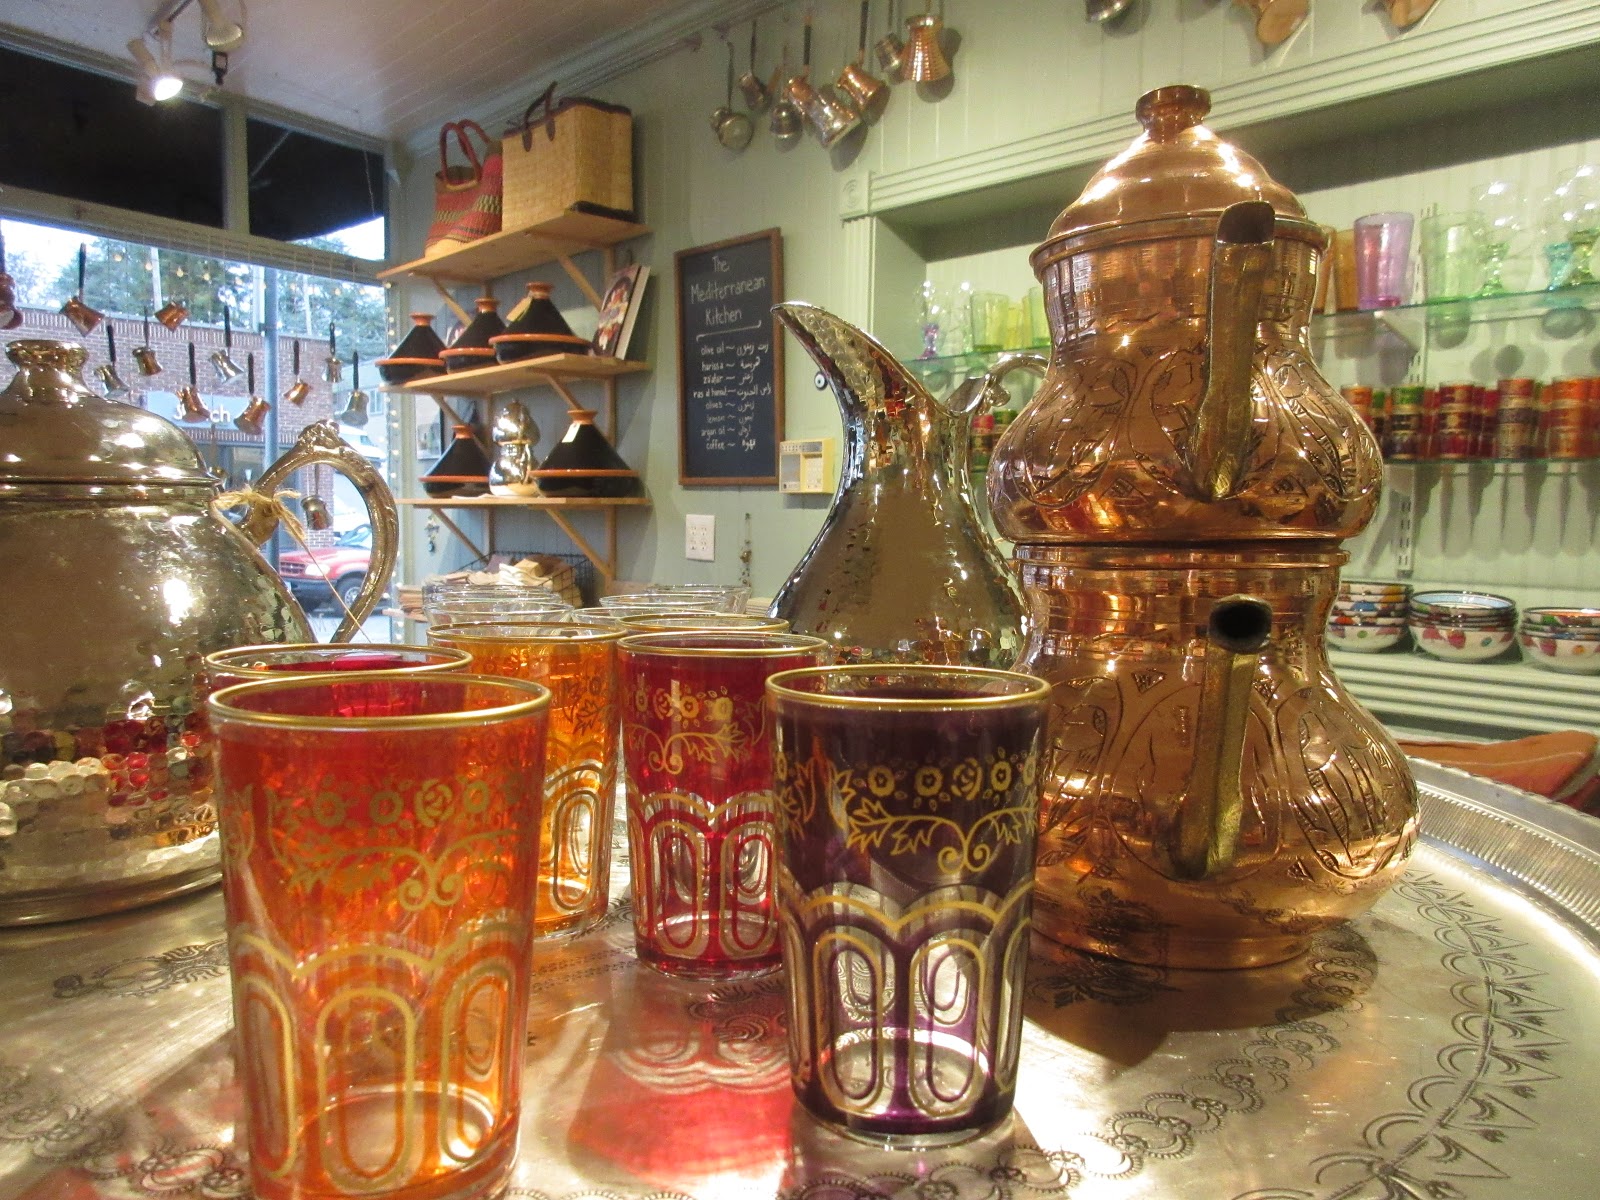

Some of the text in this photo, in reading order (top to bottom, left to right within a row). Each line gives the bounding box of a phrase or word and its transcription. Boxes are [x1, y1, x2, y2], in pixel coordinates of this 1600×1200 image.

[712, 255, 730, 273] The
[690, 277, 766, 304] Mediterranean
[705, 305, 742, 326] Kitchen
[700, 341, 725, 355] olive oil
[705, 439, 726, 450] coffee
